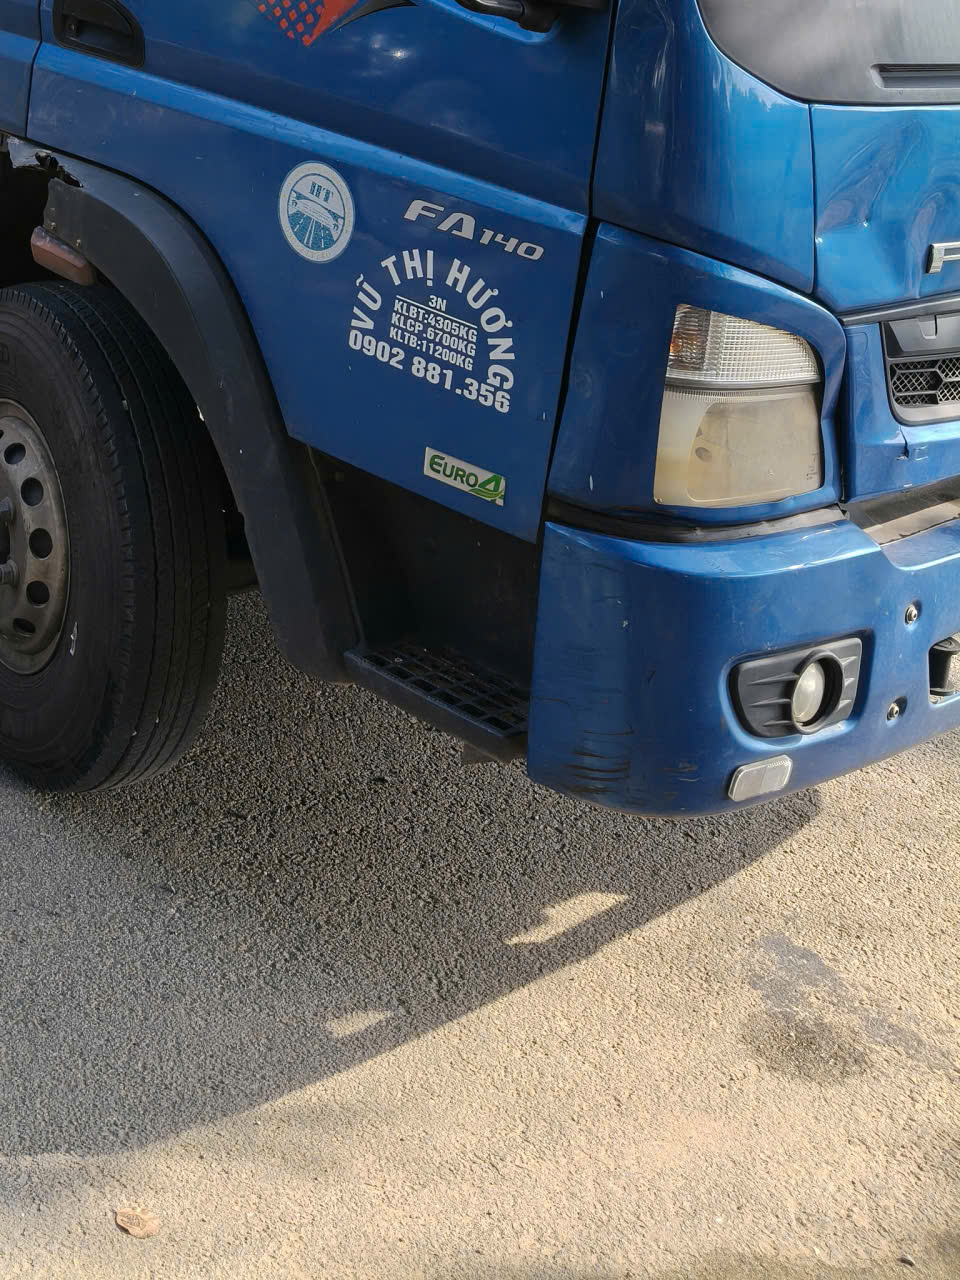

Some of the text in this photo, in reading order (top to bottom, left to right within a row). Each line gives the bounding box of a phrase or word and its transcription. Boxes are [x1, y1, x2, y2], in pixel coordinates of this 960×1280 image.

[351, 249, 515, 390] VŨ THỊ HƯƠNG
[394, 300, 478, 343] KLBT:4305KG
[429, 295, 447, 312] 3N
[348, 329, 510, 413] 0902 881.356
[389, 327, 473, 371] KLTB:11200KG
